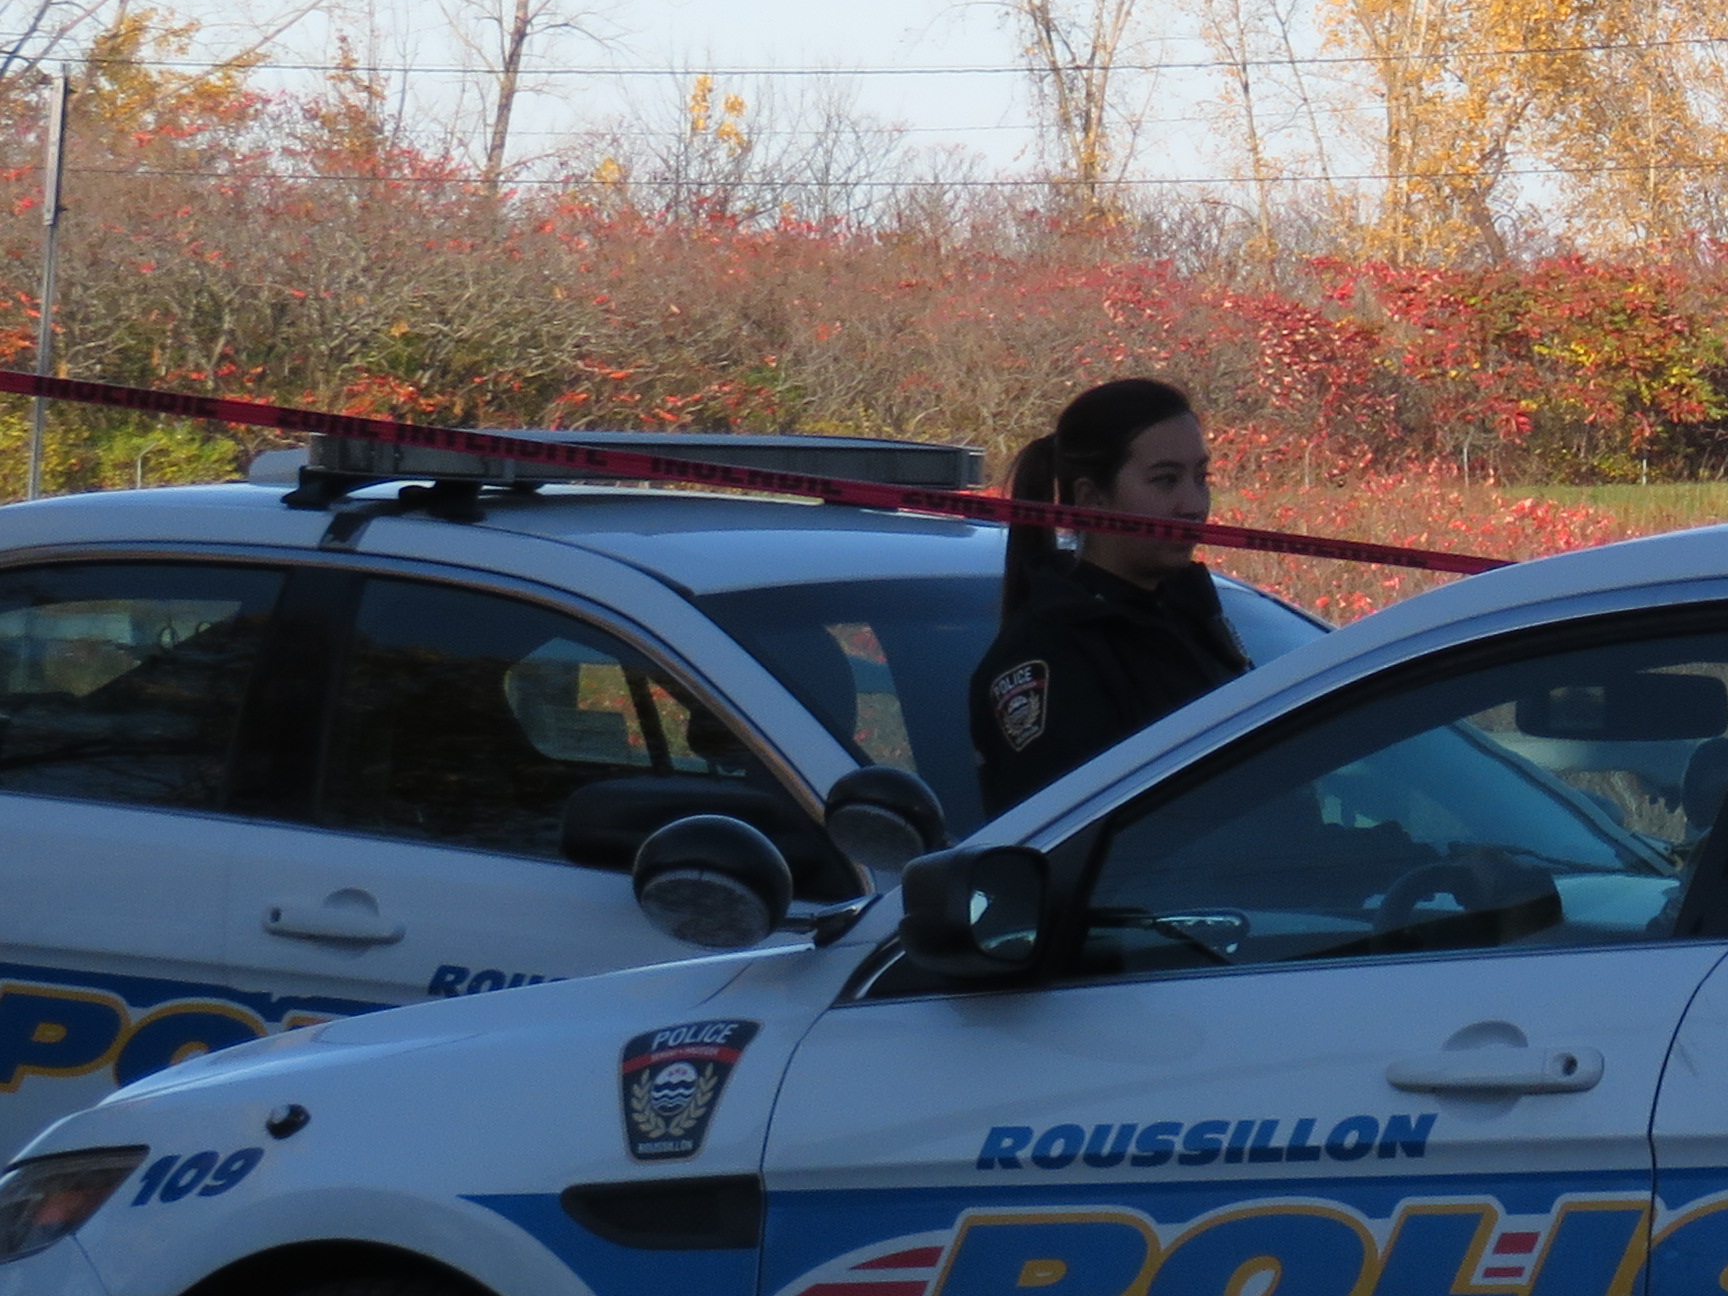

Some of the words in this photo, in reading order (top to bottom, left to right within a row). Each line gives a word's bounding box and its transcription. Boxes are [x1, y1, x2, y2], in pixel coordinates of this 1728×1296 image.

[427, 964, 571, 999] RO
[0, 983, 335, 1094] PO
[651, 1023, 739, 1051] POLICE
[975, 1114, 1438, 1171] ROUSSILLON
[130, 1147, 265, 1207] 109
